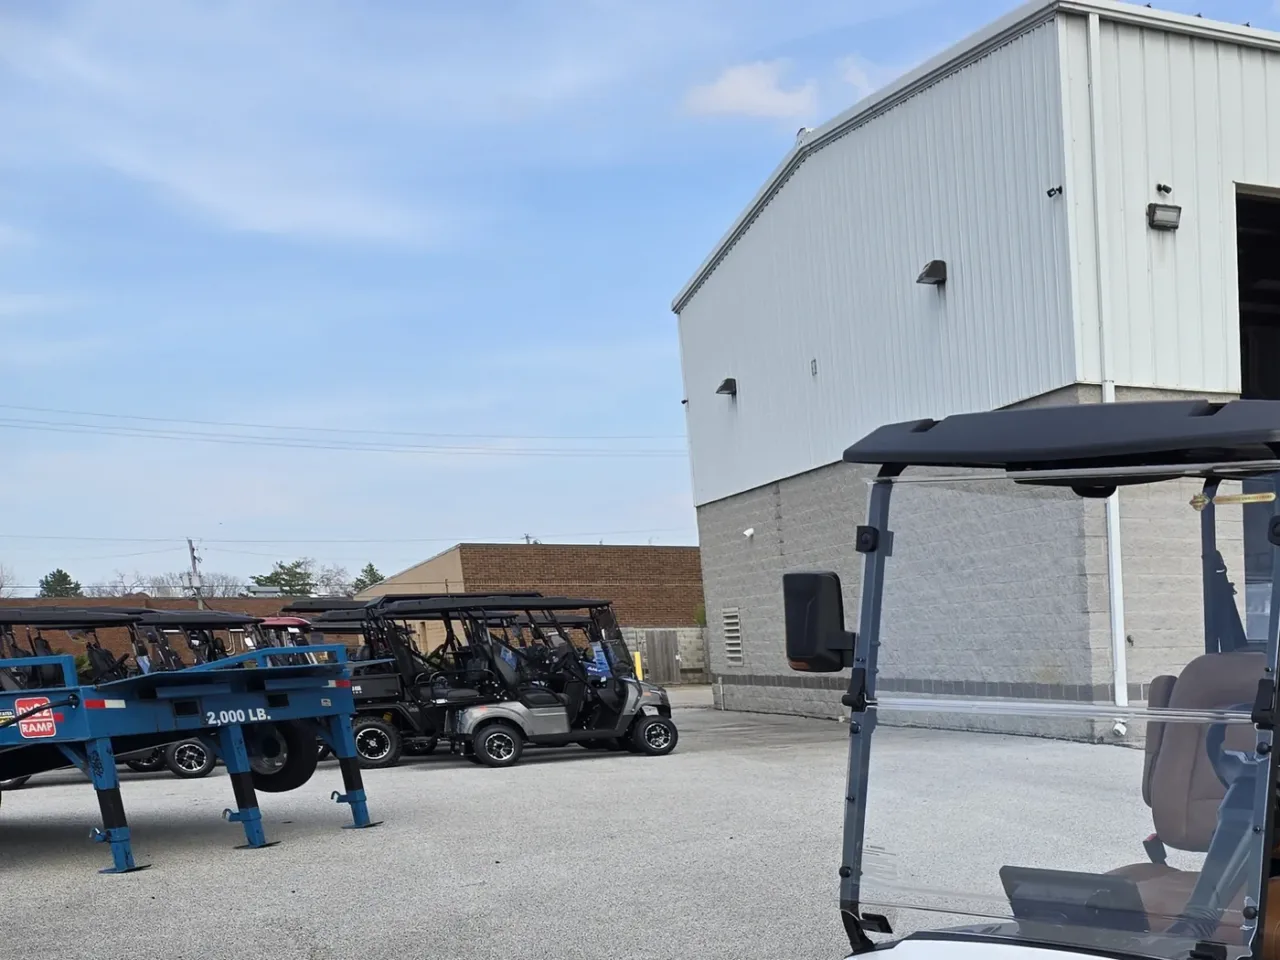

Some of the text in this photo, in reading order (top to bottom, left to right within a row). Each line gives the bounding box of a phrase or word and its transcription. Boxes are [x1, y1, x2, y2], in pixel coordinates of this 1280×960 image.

[206, 708, 272, 727] 2,000 LB.
[21, 722, 53, 733] RAMP
